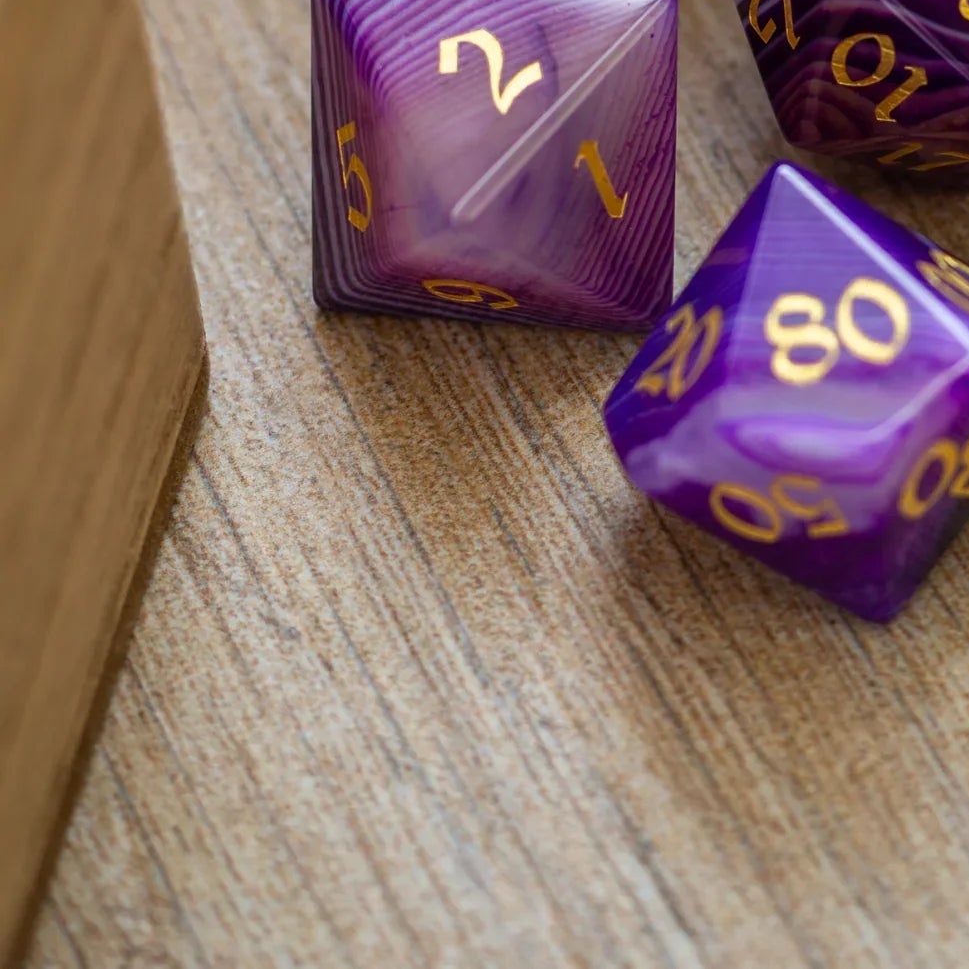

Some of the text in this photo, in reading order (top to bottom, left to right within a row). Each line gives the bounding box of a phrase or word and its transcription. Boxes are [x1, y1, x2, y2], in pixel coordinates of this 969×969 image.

[439, 28, 544, 115] 2
[831, 32, 929, 123] 10
[336, 121, 372, 232] 5
[574, 139, 628, 219] 1
[635, 303, 724, 401] 20
[764, 277, 911, 386] 80
[708, 473, 850, 544] 50
